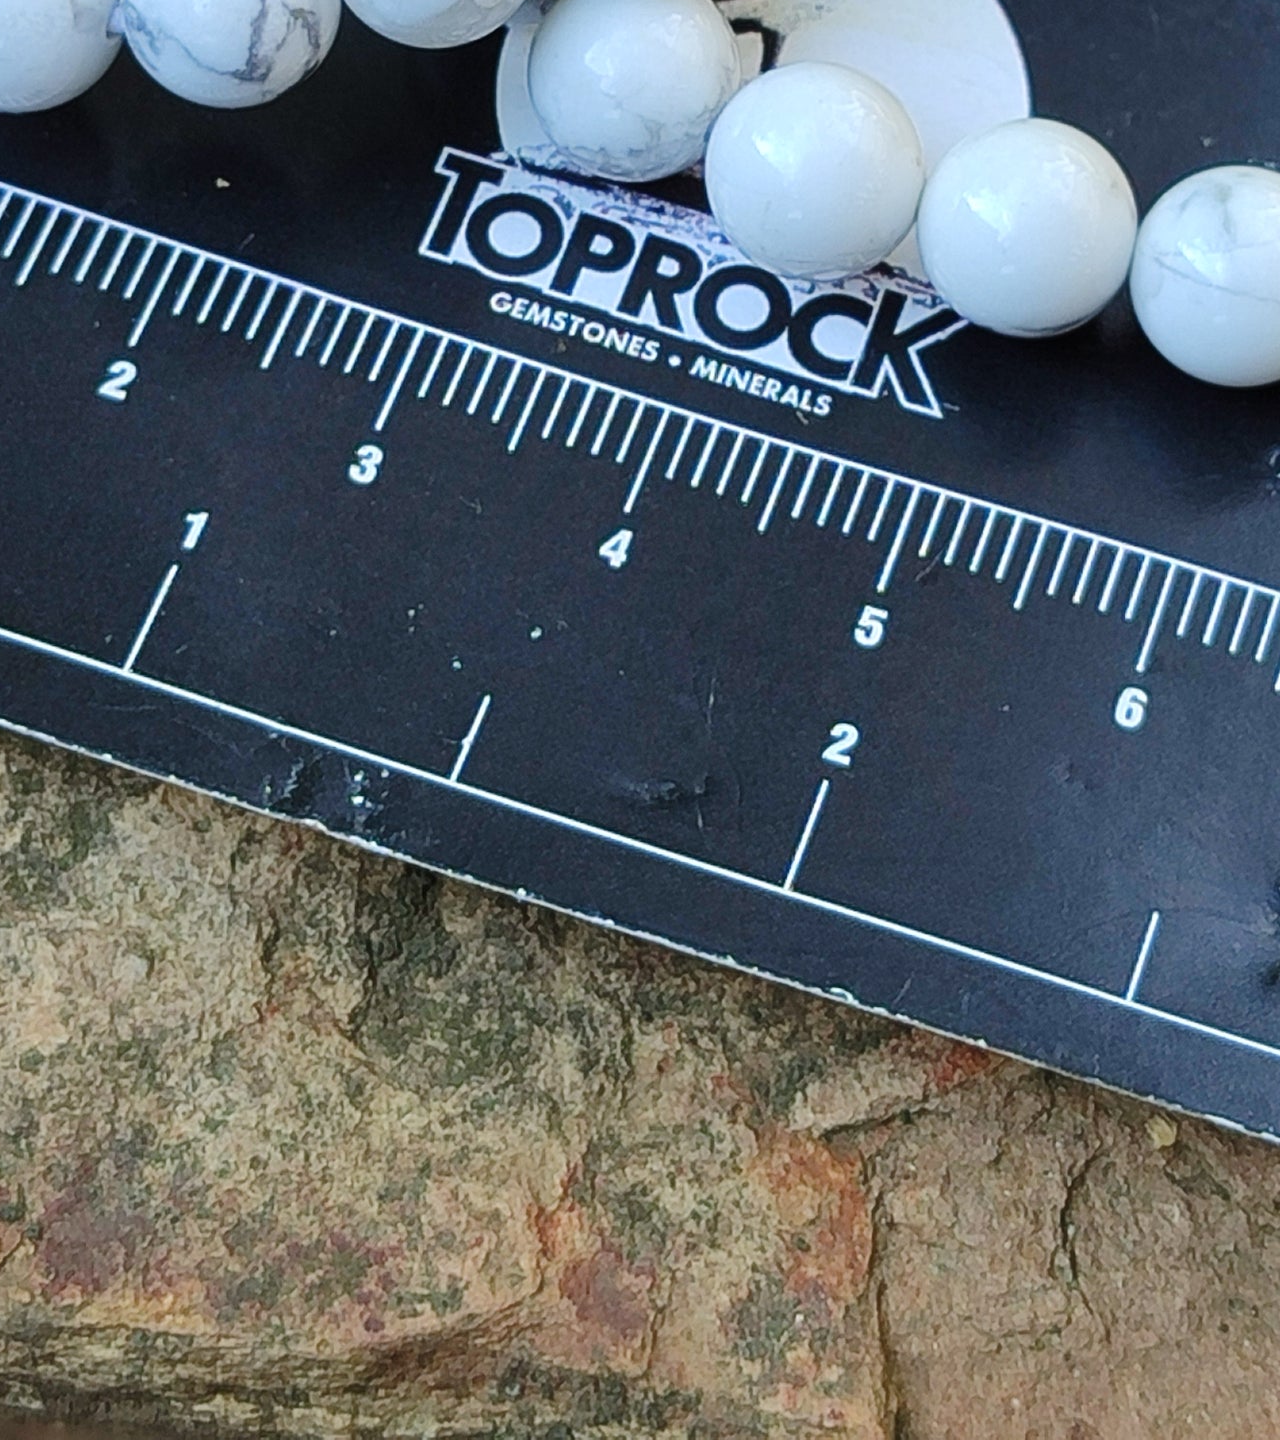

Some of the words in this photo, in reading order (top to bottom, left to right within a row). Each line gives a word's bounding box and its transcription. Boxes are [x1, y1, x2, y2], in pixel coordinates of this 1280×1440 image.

[424, 150, 966, 415] TOPROCK
[489, 290, 661, 363] GEMSTONES
[689, 356, 833, 417] MINERALS
[97, 360, 137, 401] 2
[348, 444, 385, 485] 3
[598, 528, 634, 568] 4
[853, 605, 889, 648] 5
[1114, 686, 1149, 729] 6
[182, 511, 210, 550] 1
[821, 722, 859, 765] 2
